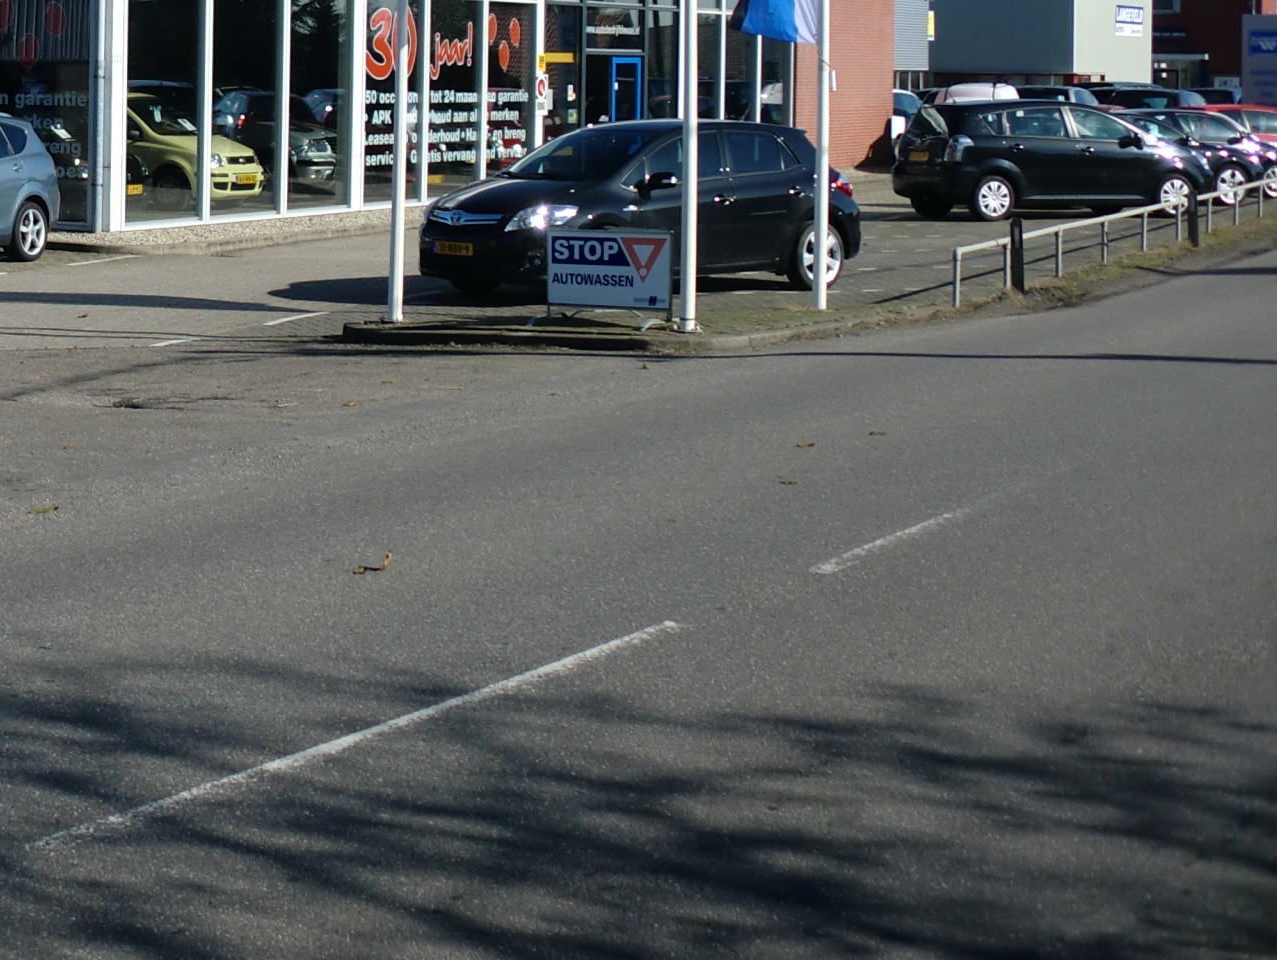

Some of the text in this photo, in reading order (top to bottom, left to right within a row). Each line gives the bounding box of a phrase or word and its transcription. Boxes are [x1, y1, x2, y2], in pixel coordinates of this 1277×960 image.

[430, 21, 473, 80] jaar!
[15, 90, 88, 109] garantie
[365, 89, 529, 105] 50 occon tot 24 maanen garantie
[372, 110, 392, 124] APK
[453, 111, 467, 123] aan
[491, 107, 519, 122] merken
[412, 128, 461, 143] oderhoud
[493, 129, 503, 141] en
[504, 127, 526, 141] breng
[46, 142, 82, 157] reng
[365, 146, 527, 166] servic Gatis vervangnd verver
[554, 239, 619, 261] STOP
[552, 272, 634, 287] AUTOWASSEN
